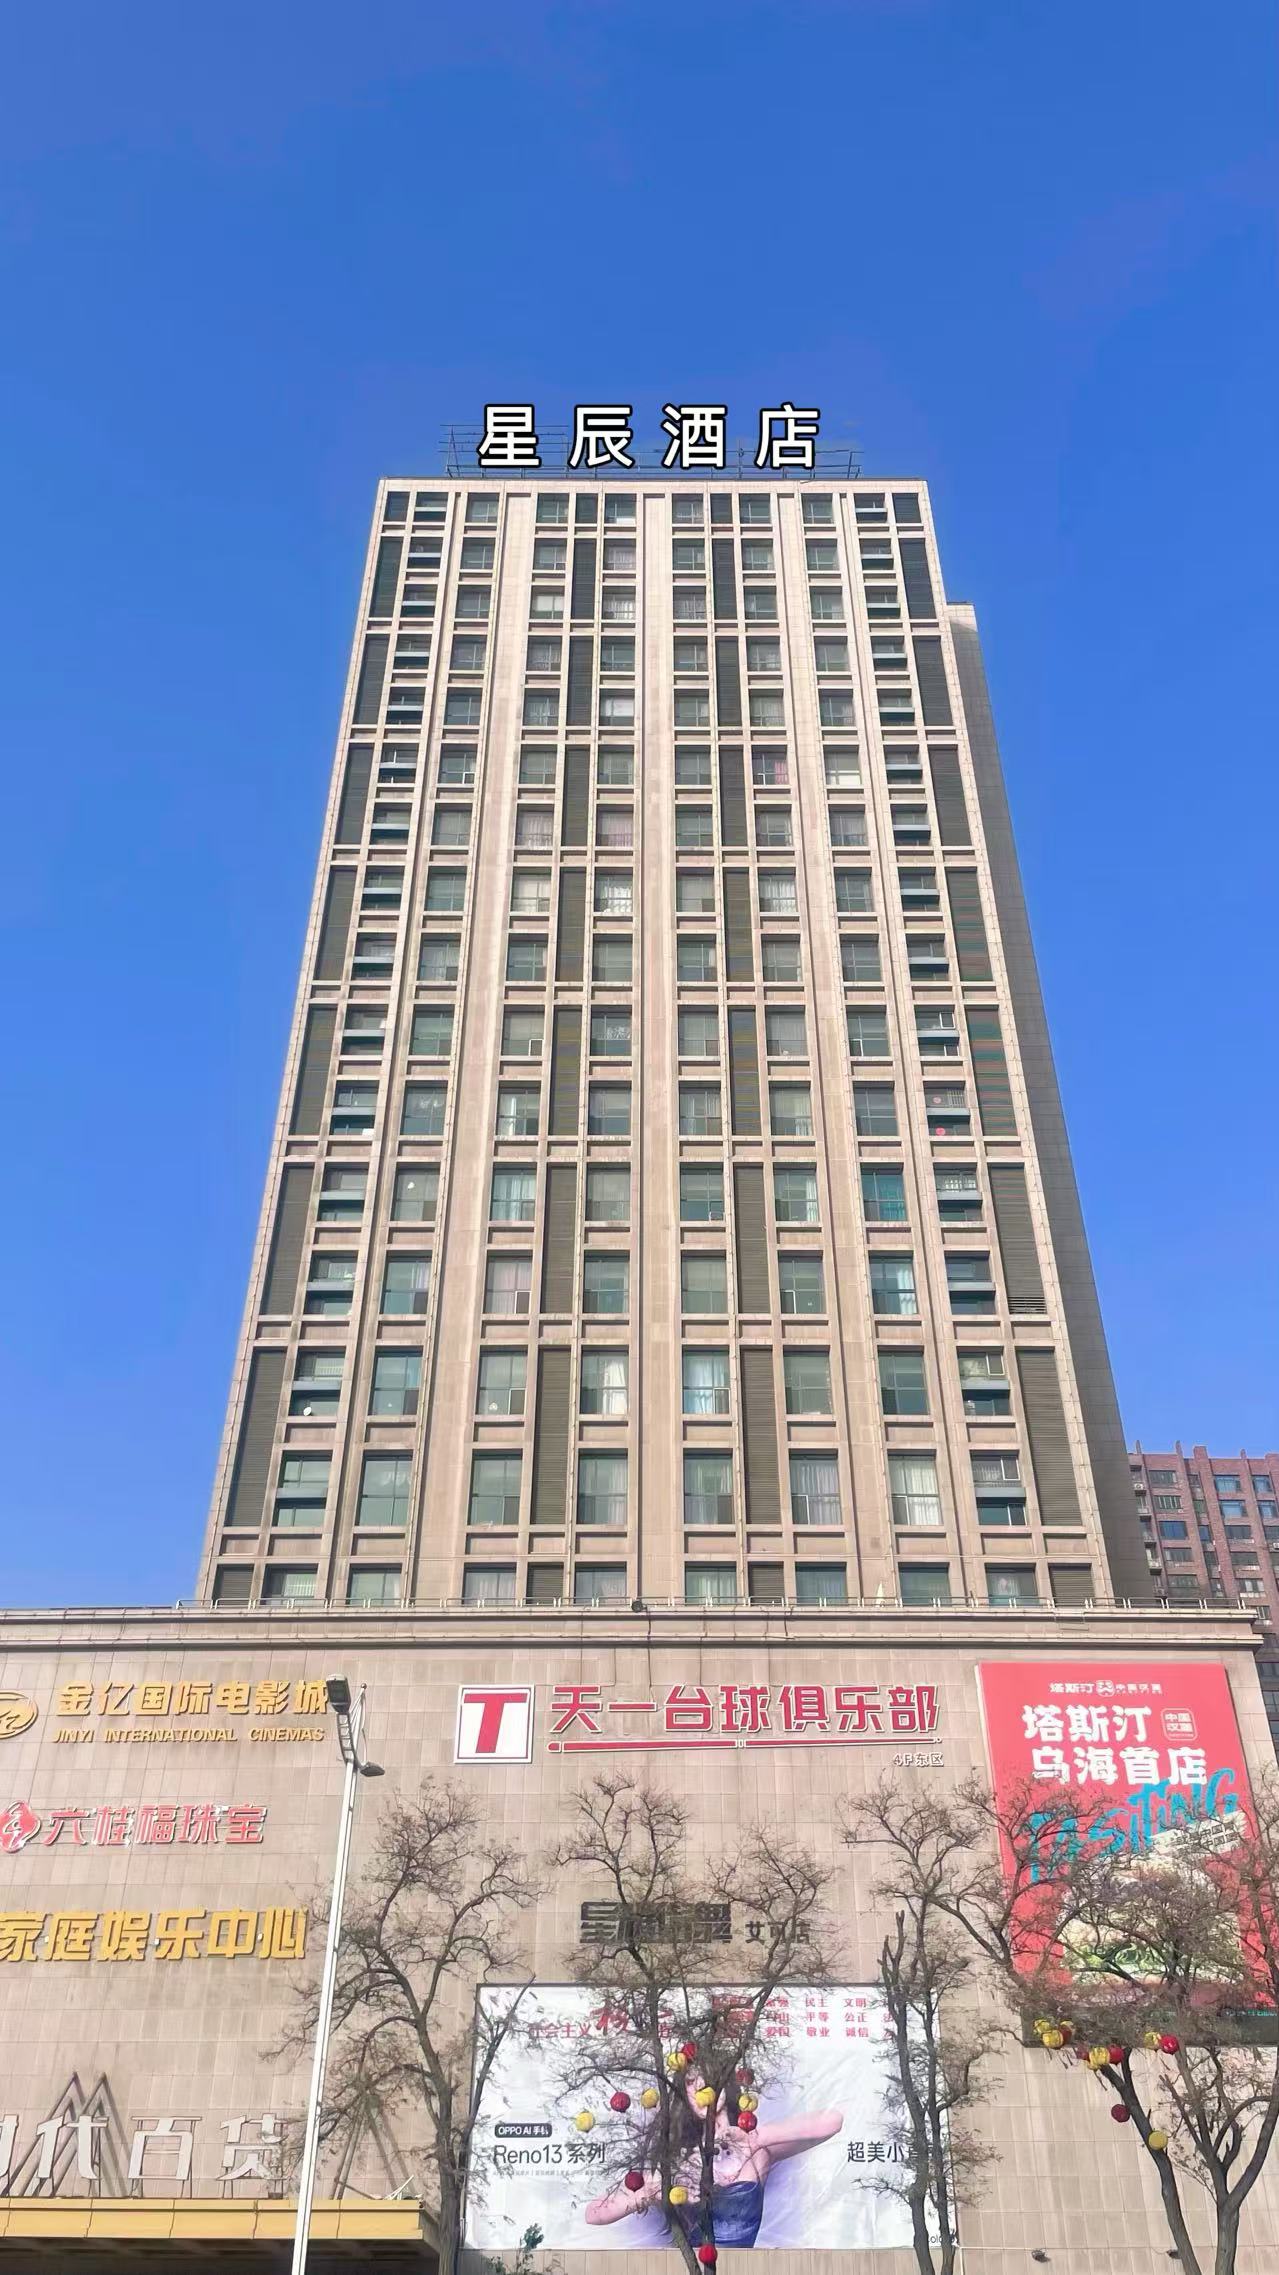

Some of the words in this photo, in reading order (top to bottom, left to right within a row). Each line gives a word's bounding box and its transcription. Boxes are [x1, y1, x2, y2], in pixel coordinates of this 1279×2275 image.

[55, 1680, 328, 1716] 金亿国际电影城
[551, 1684, 939, 1732] 天一台球俱乐部
[53, 1728, 94, 1743] JINYI
[104, 1728, 237, 1742] INTERNATIONAL
[249, 1727, 324, 1741] CINEMAS
[463, 1692, 527, 1753] T
[1022, 1704, 1151, 1742] 塔斯汀
[1032, 1747, 1207, 1785] 乌海首店
[42, 1804, 267, 1846] 六桂福珠宝
[0, 1908, 308, 1961] 家庭娱乐中心
[0, 2113, 288, 2182] 代百货
[499, 2126, 525, 2136] OPPO
[494, 2144, 563, 2164] Reno13
[567, 2143, 605, 2164] 系列
